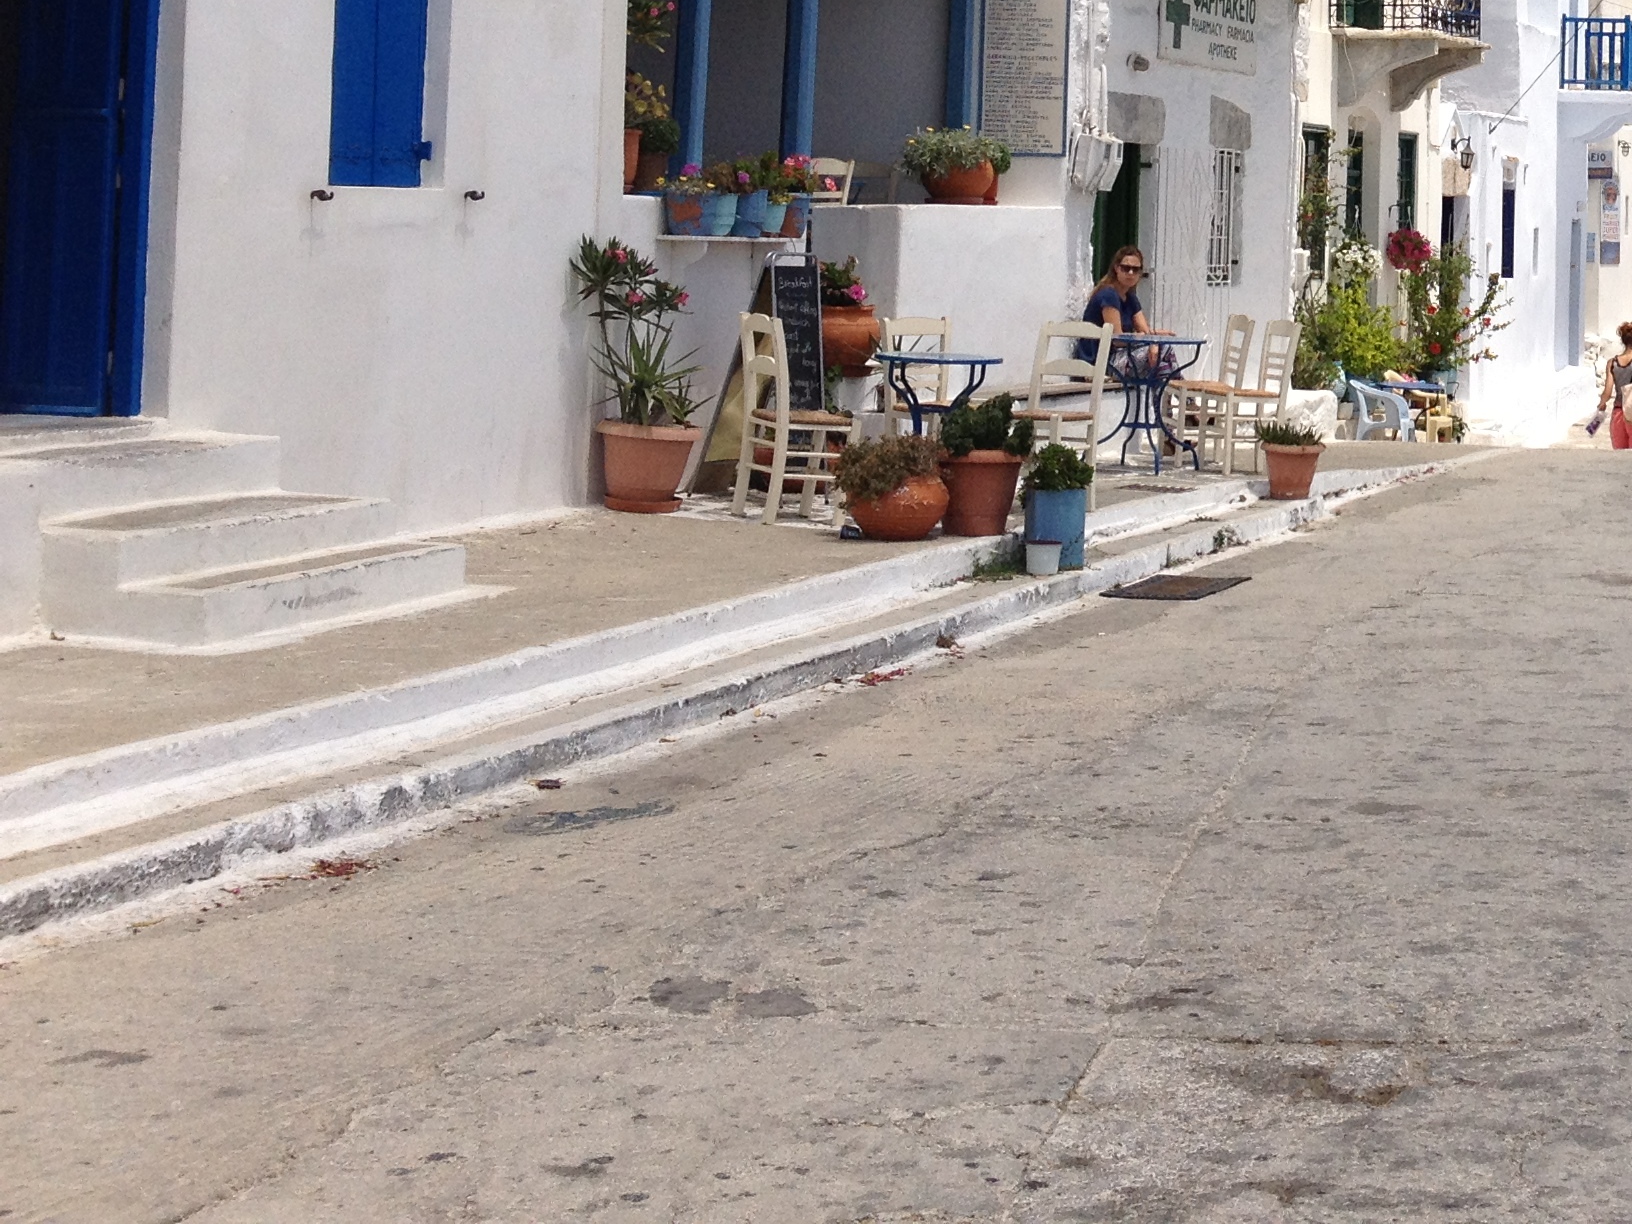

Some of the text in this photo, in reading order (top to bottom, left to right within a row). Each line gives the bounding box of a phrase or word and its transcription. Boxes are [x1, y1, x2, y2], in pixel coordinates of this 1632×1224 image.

[1191, 18, 1254, 43] PHARMACY FARMACIA
[1208, 42, 1237, 60] APOTHEKE
